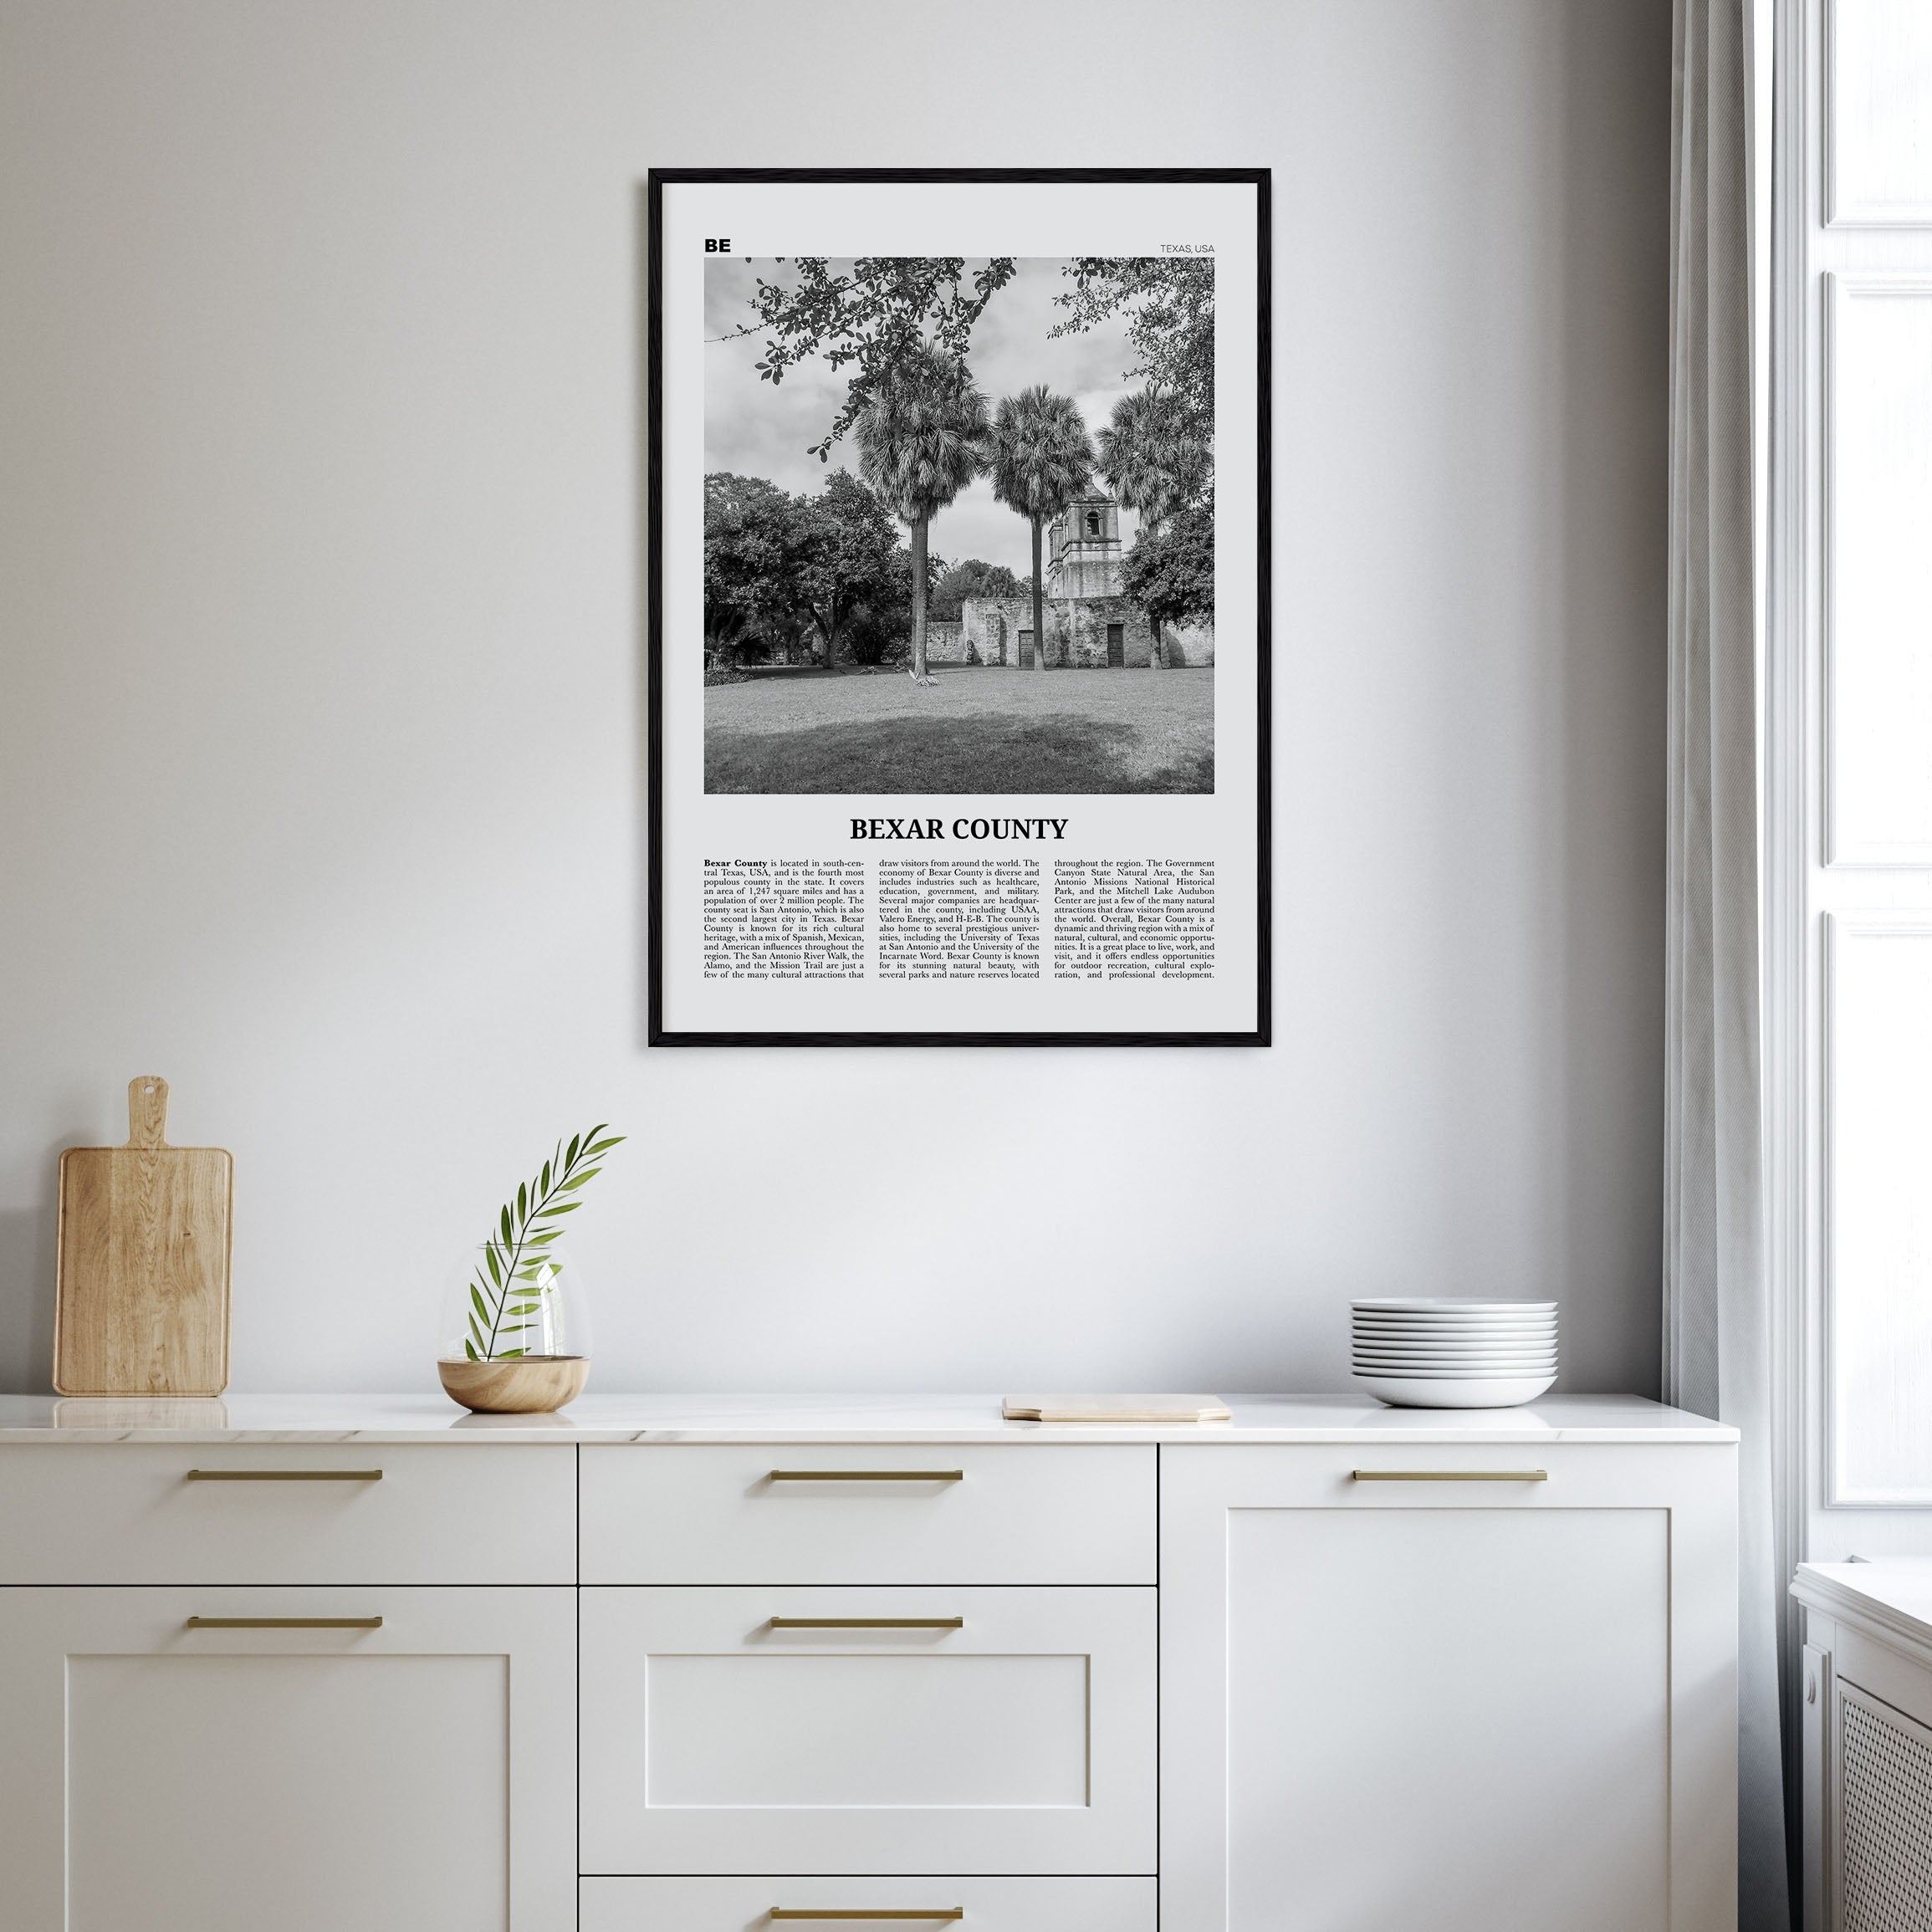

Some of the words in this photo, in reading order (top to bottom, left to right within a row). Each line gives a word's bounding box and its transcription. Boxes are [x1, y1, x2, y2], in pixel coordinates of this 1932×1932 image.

[705, 238, 731, 253] BE
[1160, 244, 1193, 253] TEXAS,
[1195, 244, 1215, 253] USA
[850, 818, 945, 840] BEXAR
[952, 818, 1069, 840] COUNTY
[734, 860, 768, 869] County
[1054, 860, 1098, 869] throughout
[1116, 860, 1143, 869] region.
[723, 869, 746, 877] Texas,
[749, 869, 771, 877] USA,
[953, 869, 984, 878] County
[1054, 869, 1085, 878] Canyon
[1153, 869, 1175, 877] Area,
[703, 878, 740, 887] populous
[744, 879, 771, 887] county
[996, 878, 1040, 887] healthcare,
[1055, 887, 1075, 896] Park,
[911, 897, 935, 906] major
[938, 897, 980, 906] companies
[999, 897, 1040, 906] headquar-
[703, 907, 731, 915] county
[777, 906, 812, 914] Antonio,
[703, 924, 733, 933] County
[1054, 924, 1088, 933] dynamic
[1106, 924, 1137, 933] thriving
[1137, 925, 1163, 933] region
[878, 934, 901, 943] sities,
[903, 933, 941, 943] including
[960, 933, 1001, 943] University
[1054, 933, 1086, 943] natural,
[1087, 933, 1121, 943] cultural,
[805, 943, 849, 953] throughout
[972, 952, 1002, 962] County
[1054, 953, 1073, 961] visit,
[1163, 953, 1215, 962] opportunities
[703, 962, 733, 970] Alamo,
[842, 962, 856, 971] just
[908, 971, 930, 980] parks
[1054, 971, 1081, 979] ration,
[1109, 971, 1156, 980] professional
[1162, 971, 1214, 980] development.
